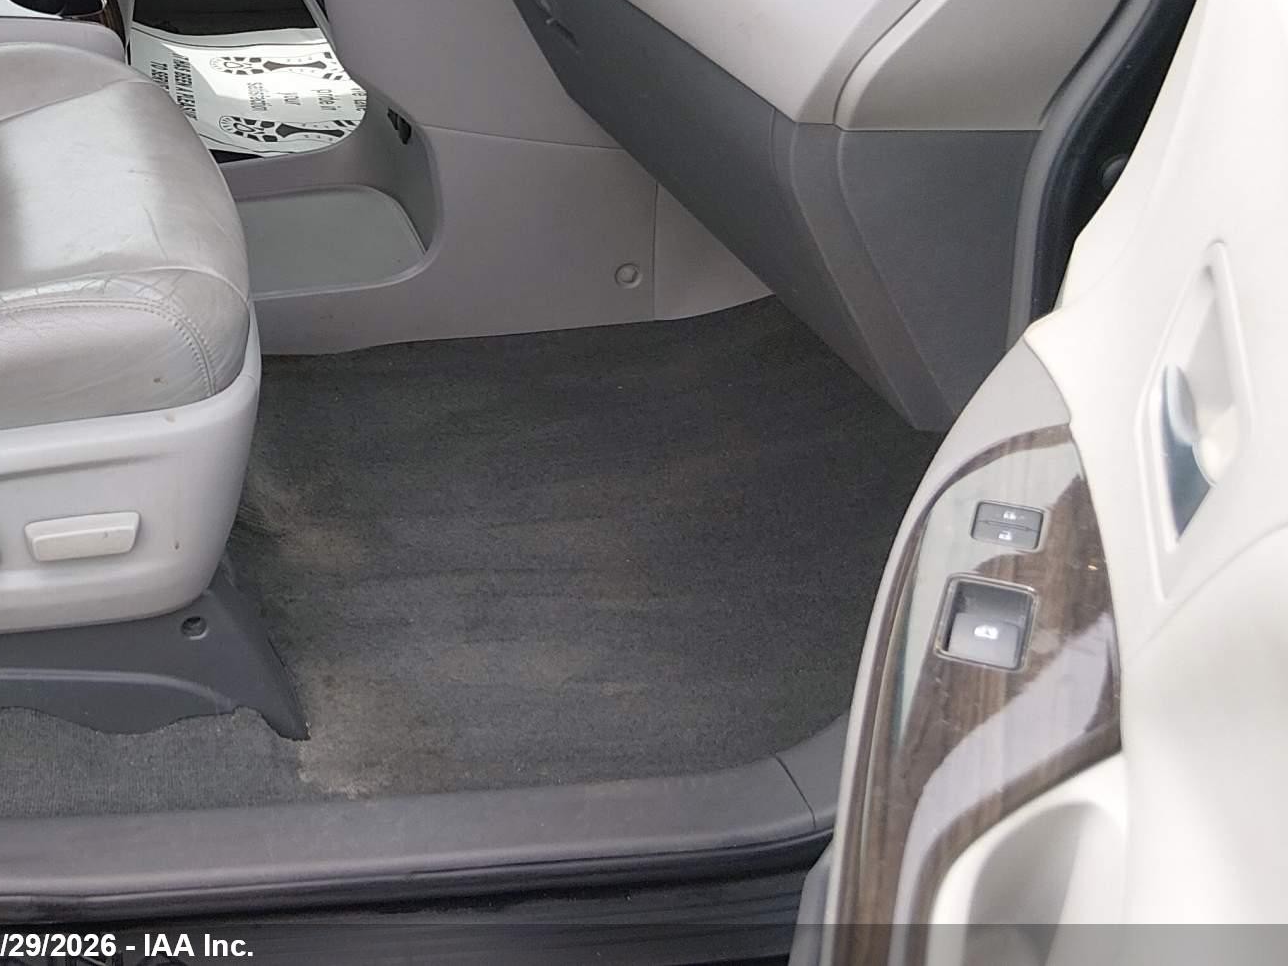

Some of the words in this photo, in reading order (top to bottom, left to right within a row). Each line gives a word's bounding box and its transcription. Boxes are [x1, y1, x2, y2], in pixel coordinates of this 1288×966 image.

[150, 61, 169, 71] TO
[173, 59, 191, 72] HAS
[174, 71, 193, 87] BEEN
